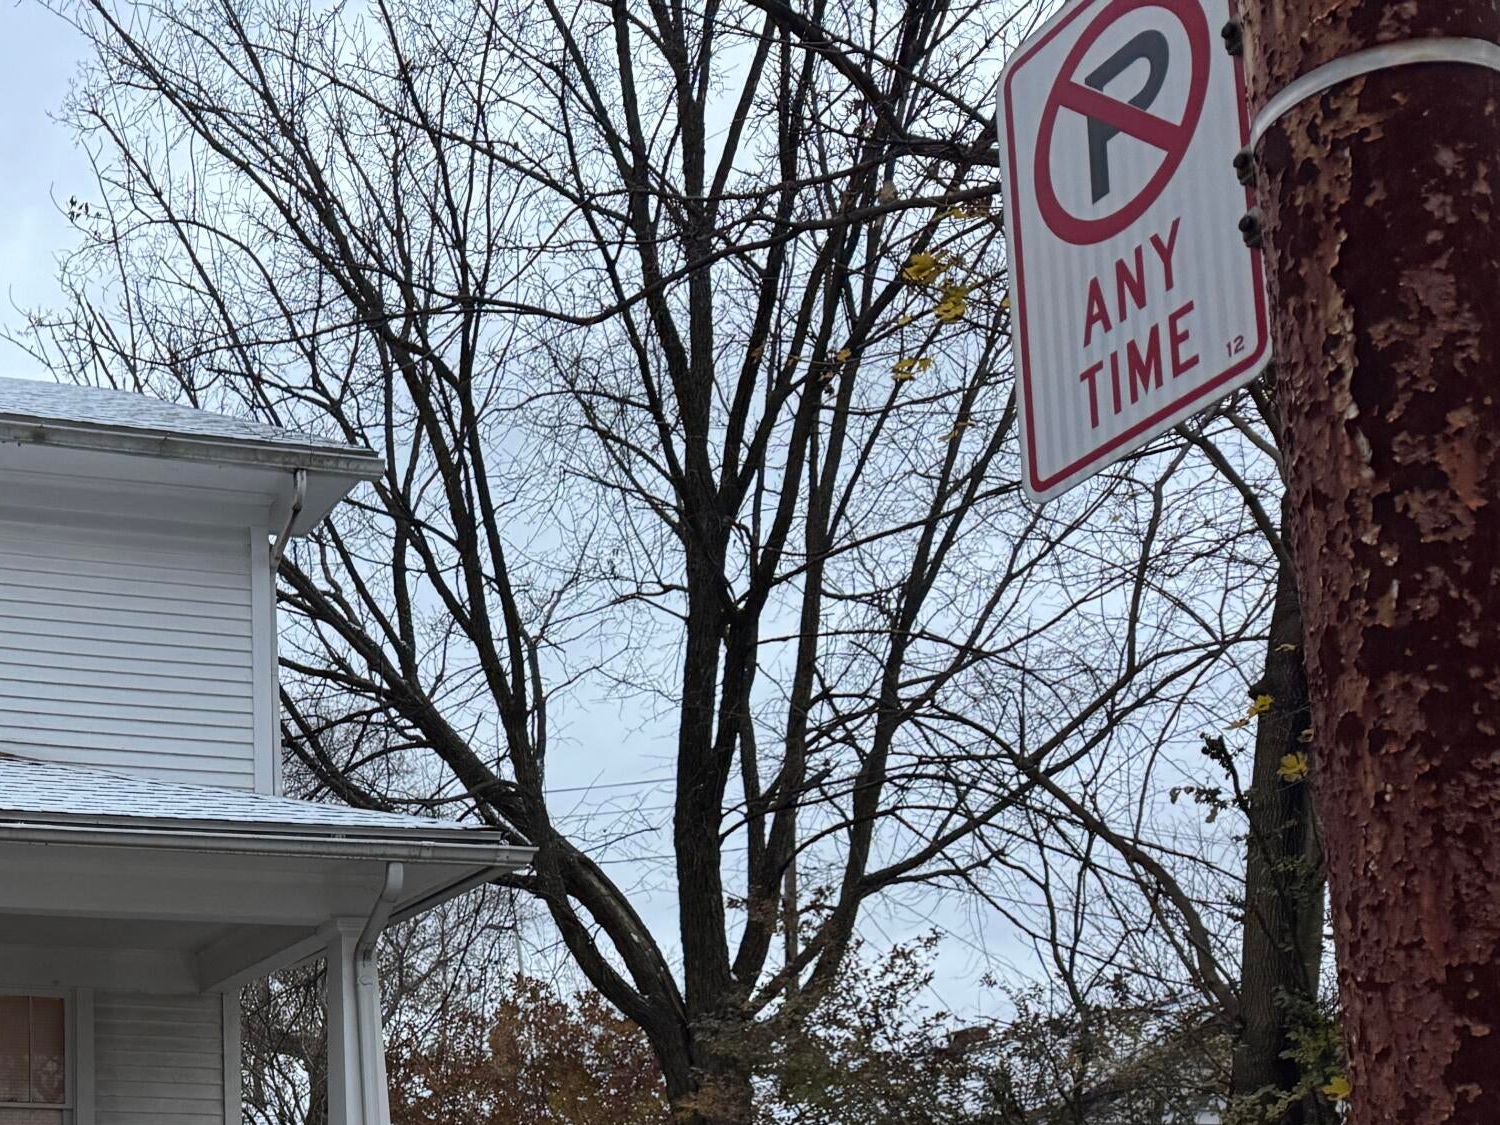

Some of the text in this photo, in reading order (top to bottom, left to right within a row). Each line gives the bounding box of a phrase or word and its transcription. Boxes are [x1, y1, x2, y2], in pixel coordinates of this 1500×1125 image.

[1084, 217, 1181, 348] ANY
[1226, 334, 1246, 359] 12
[1079, 300, 1200, 430] TIME
